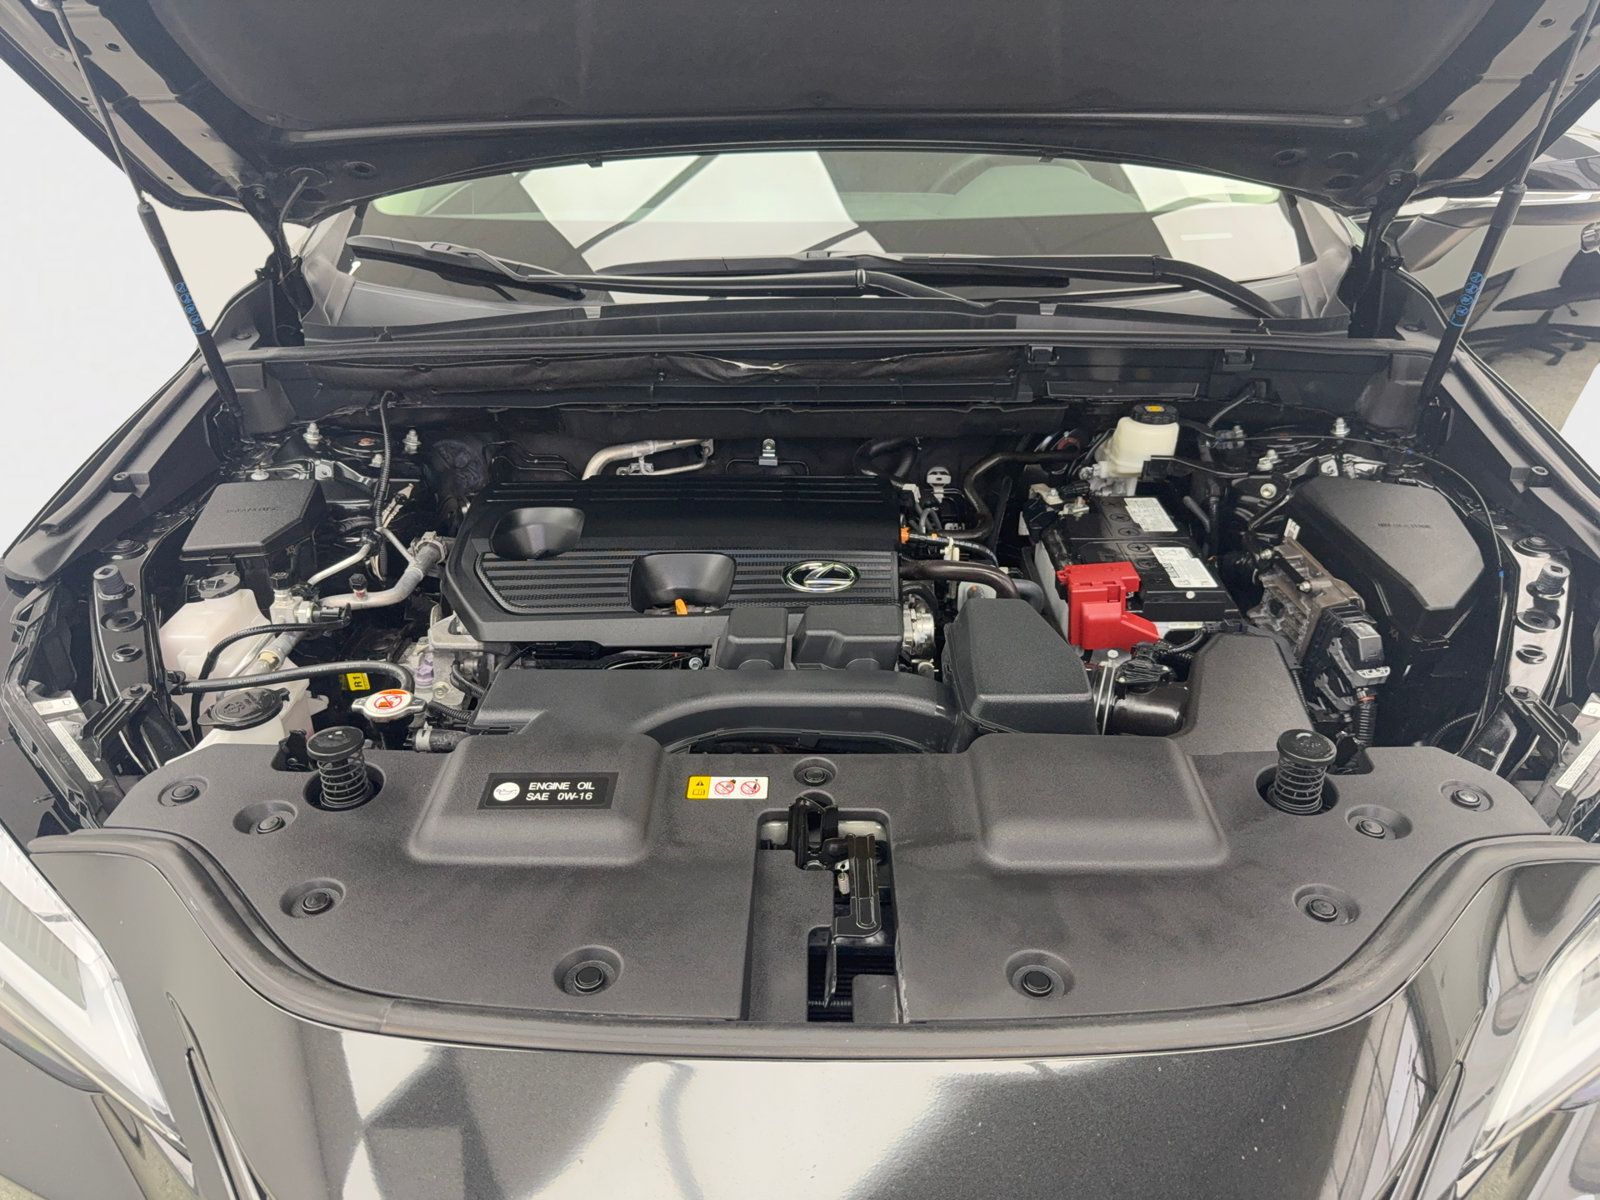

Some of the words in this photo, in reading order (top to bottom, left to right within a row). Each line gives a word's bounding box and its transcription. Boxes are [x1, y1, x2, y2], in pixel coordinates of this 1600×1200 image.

[528, 782, 571, 791] ENGINE
[577, 781, 595, 790] OIL
[525, 792, 550, 801] SAE
[557, 792, 593, 801] 0W-16
